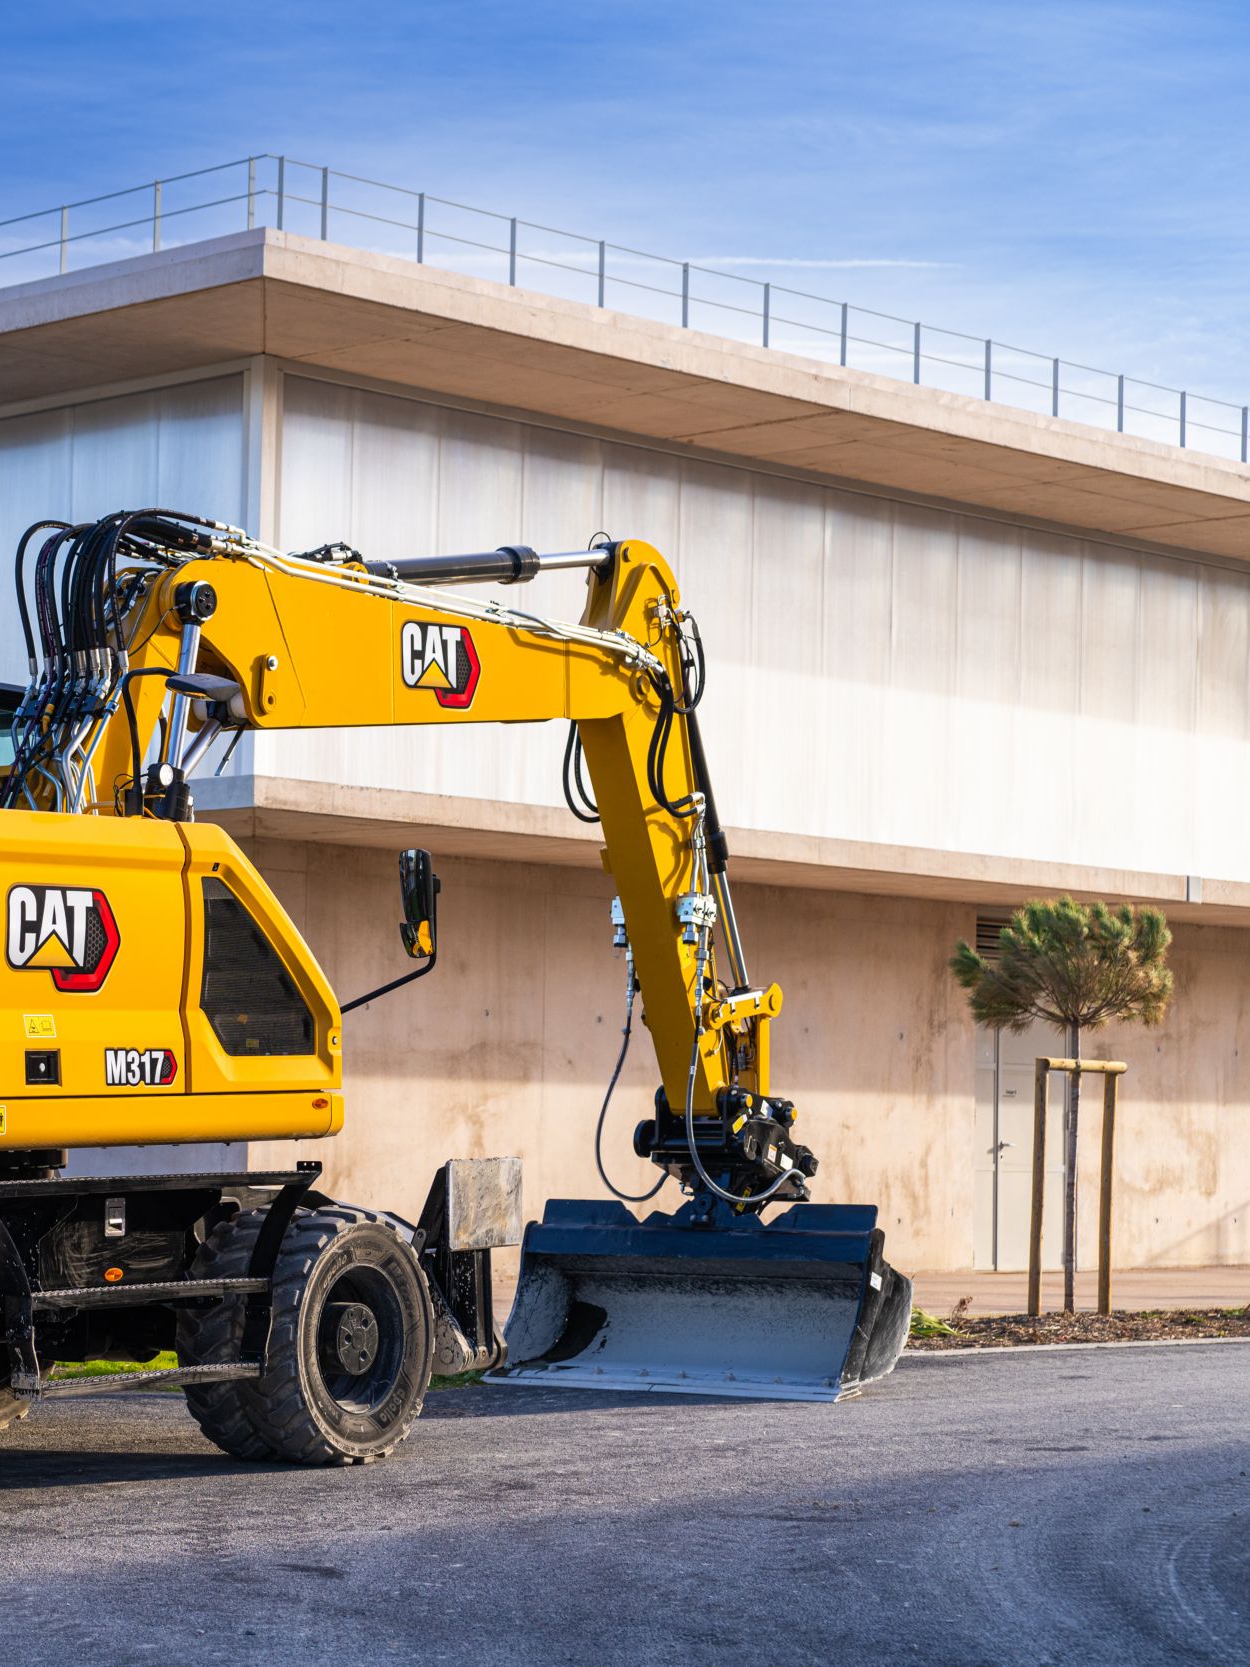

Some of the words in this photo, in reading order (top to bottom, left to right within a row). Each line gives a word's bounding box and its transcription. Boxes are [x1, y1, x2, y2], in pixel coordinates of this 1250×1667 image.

[402, 622, 461, 689] CAT
[8, 886, 94, 967] CAT
[105, 1049, 165, 1085] M317
[379, 1387, 407, 1424] apollo
